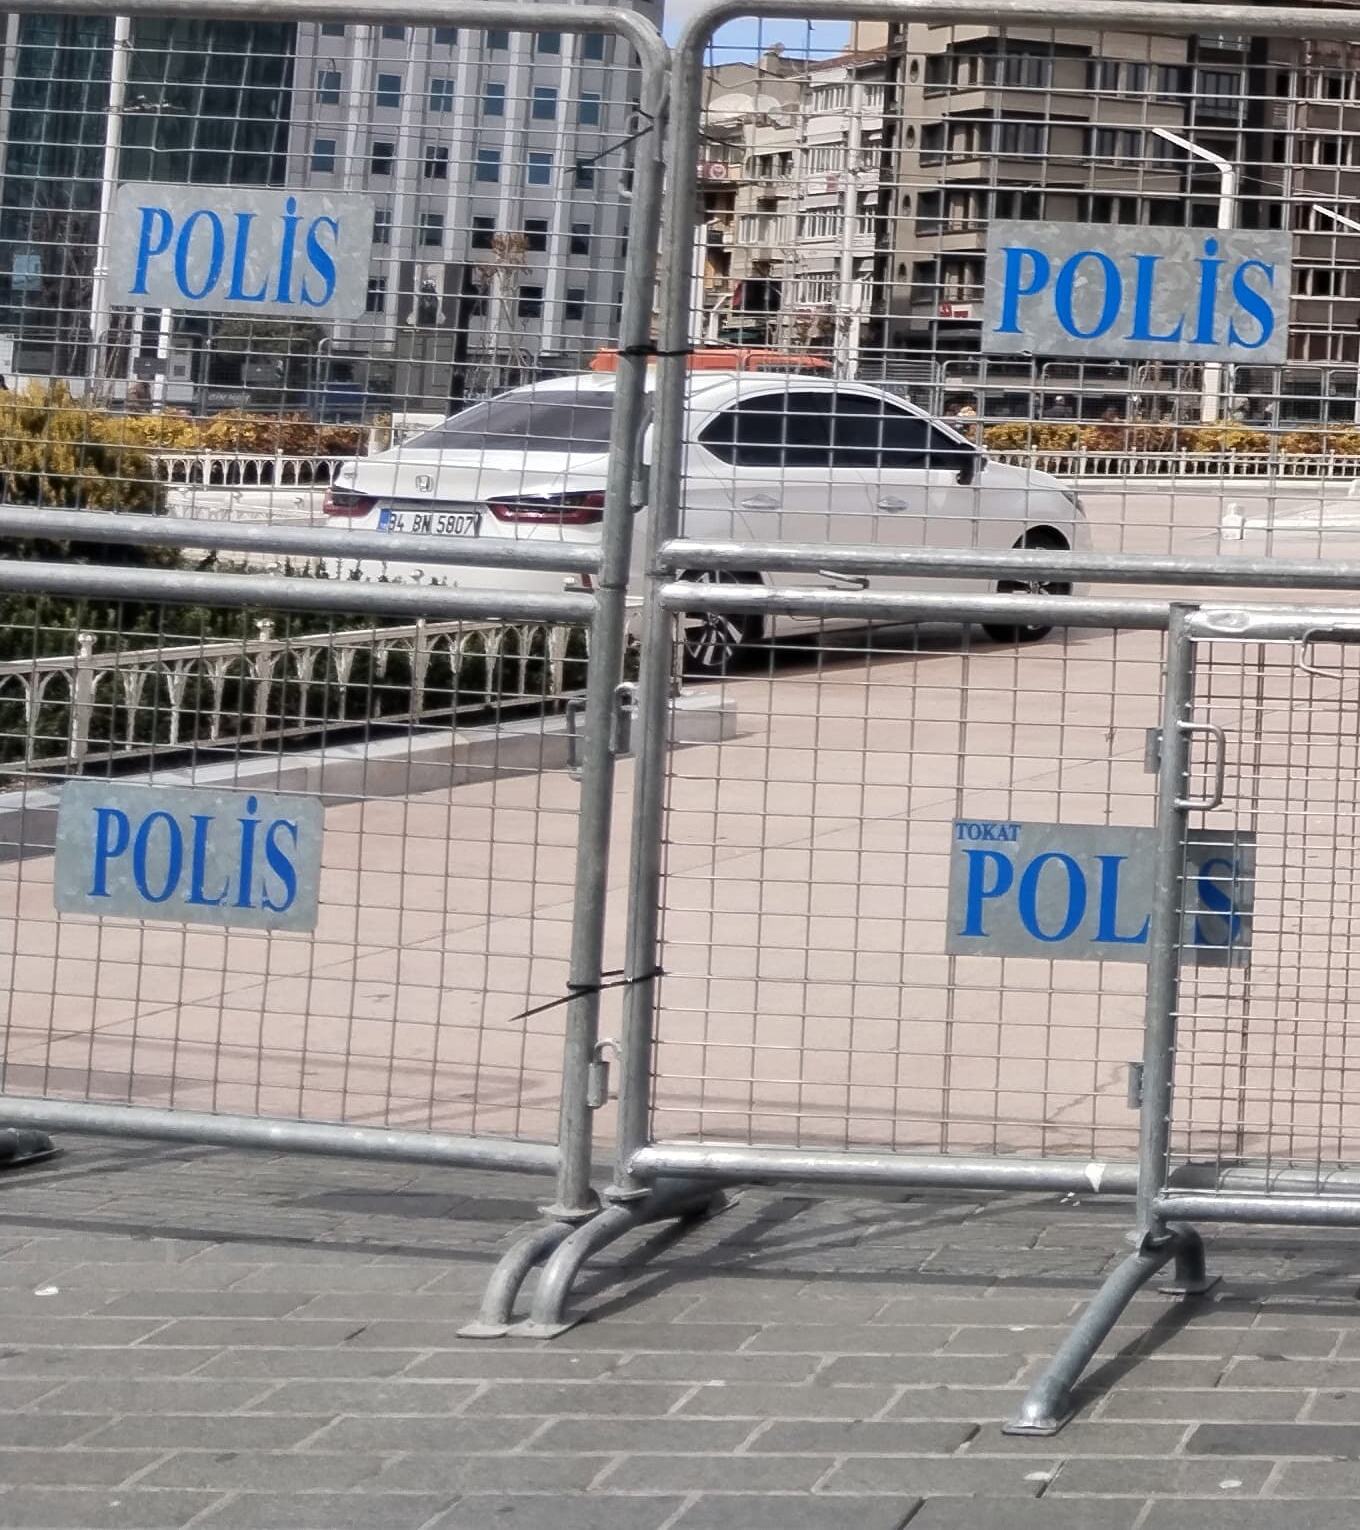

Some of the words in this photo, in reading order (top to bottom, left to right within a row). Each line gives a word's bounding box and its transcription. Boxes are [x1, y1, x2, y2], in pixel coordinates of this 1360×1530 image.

[129, 196, 341, 308] POLİS
[991, 237, 1276, 350] POLİS
[87, 795, 298, 913] POLİS
[956, 822, 1022, 842] TOKAT
[956, 848, 1242, 947] POLS
